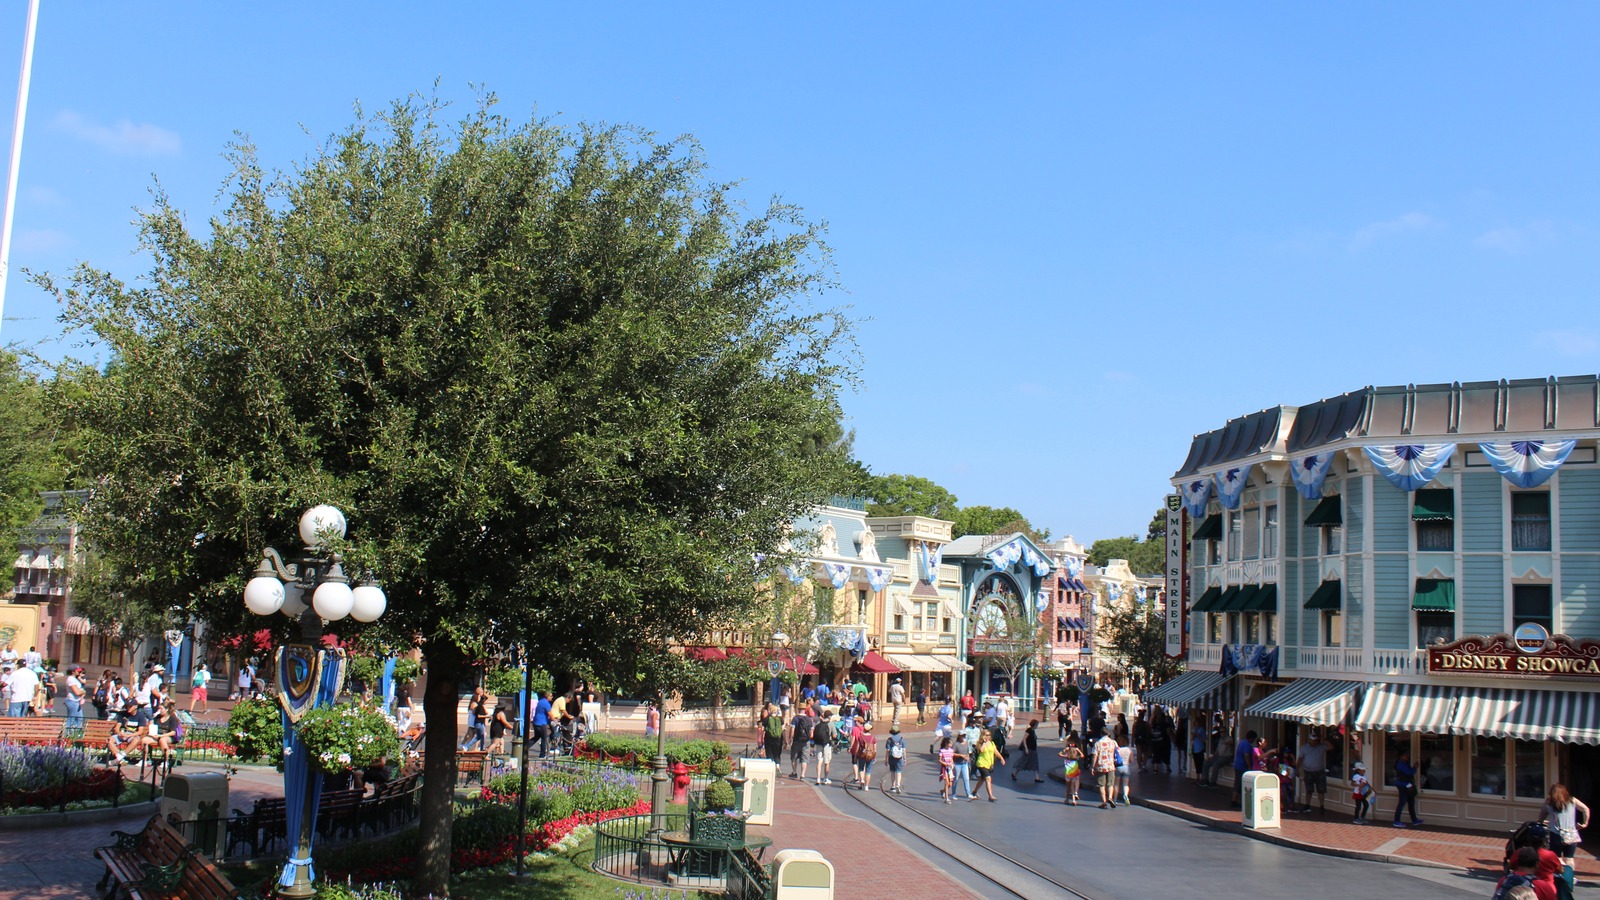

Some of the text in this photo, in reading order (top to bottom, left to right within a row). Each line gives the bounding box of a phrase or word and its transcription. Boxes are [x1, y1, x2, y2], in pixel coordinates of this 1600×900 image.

[1170, 518, 1179, 629] MAIN STREET
[1441, 653, 1511, 670] DISNEY
